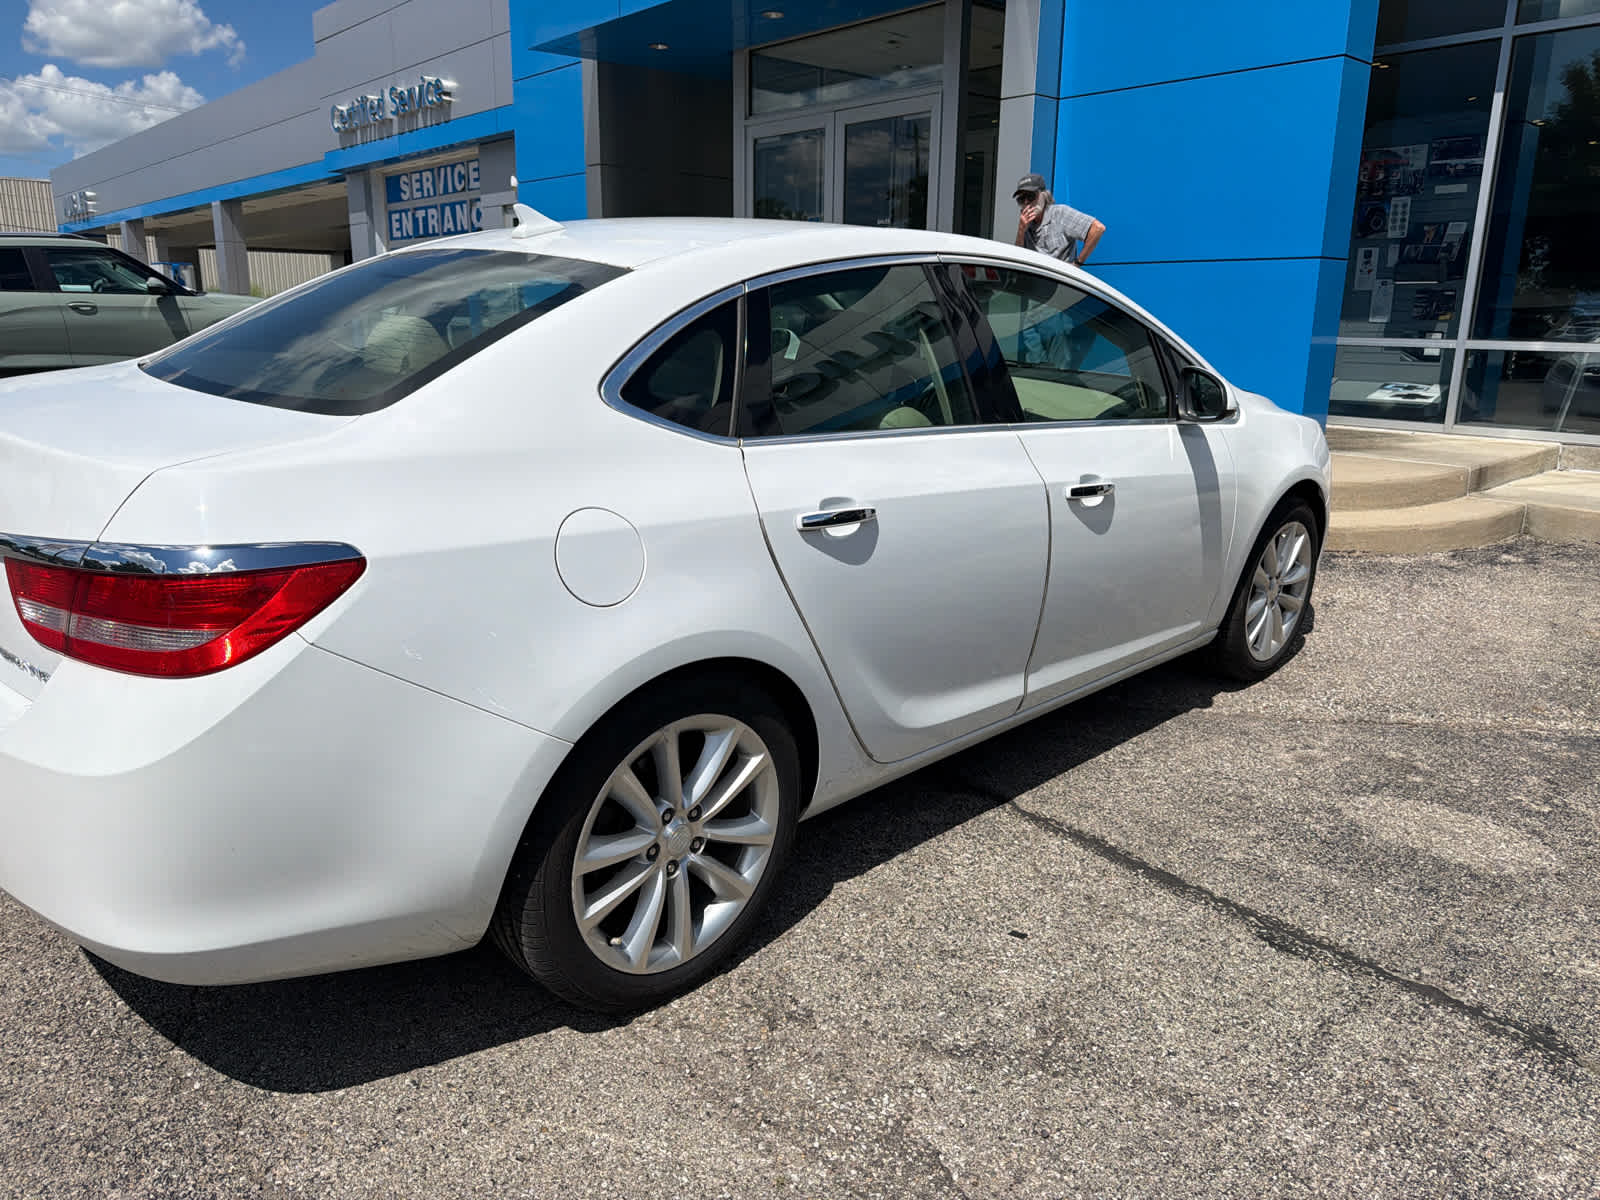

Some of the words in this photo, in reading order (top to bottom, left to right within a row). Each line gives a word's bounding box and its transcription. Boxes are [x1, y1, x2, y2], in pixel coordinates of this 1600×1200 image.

[331, 88, 385, 132] Certified
[389, 76, 443, 116] Service
[400, 161, 480, 200] SERVICE
